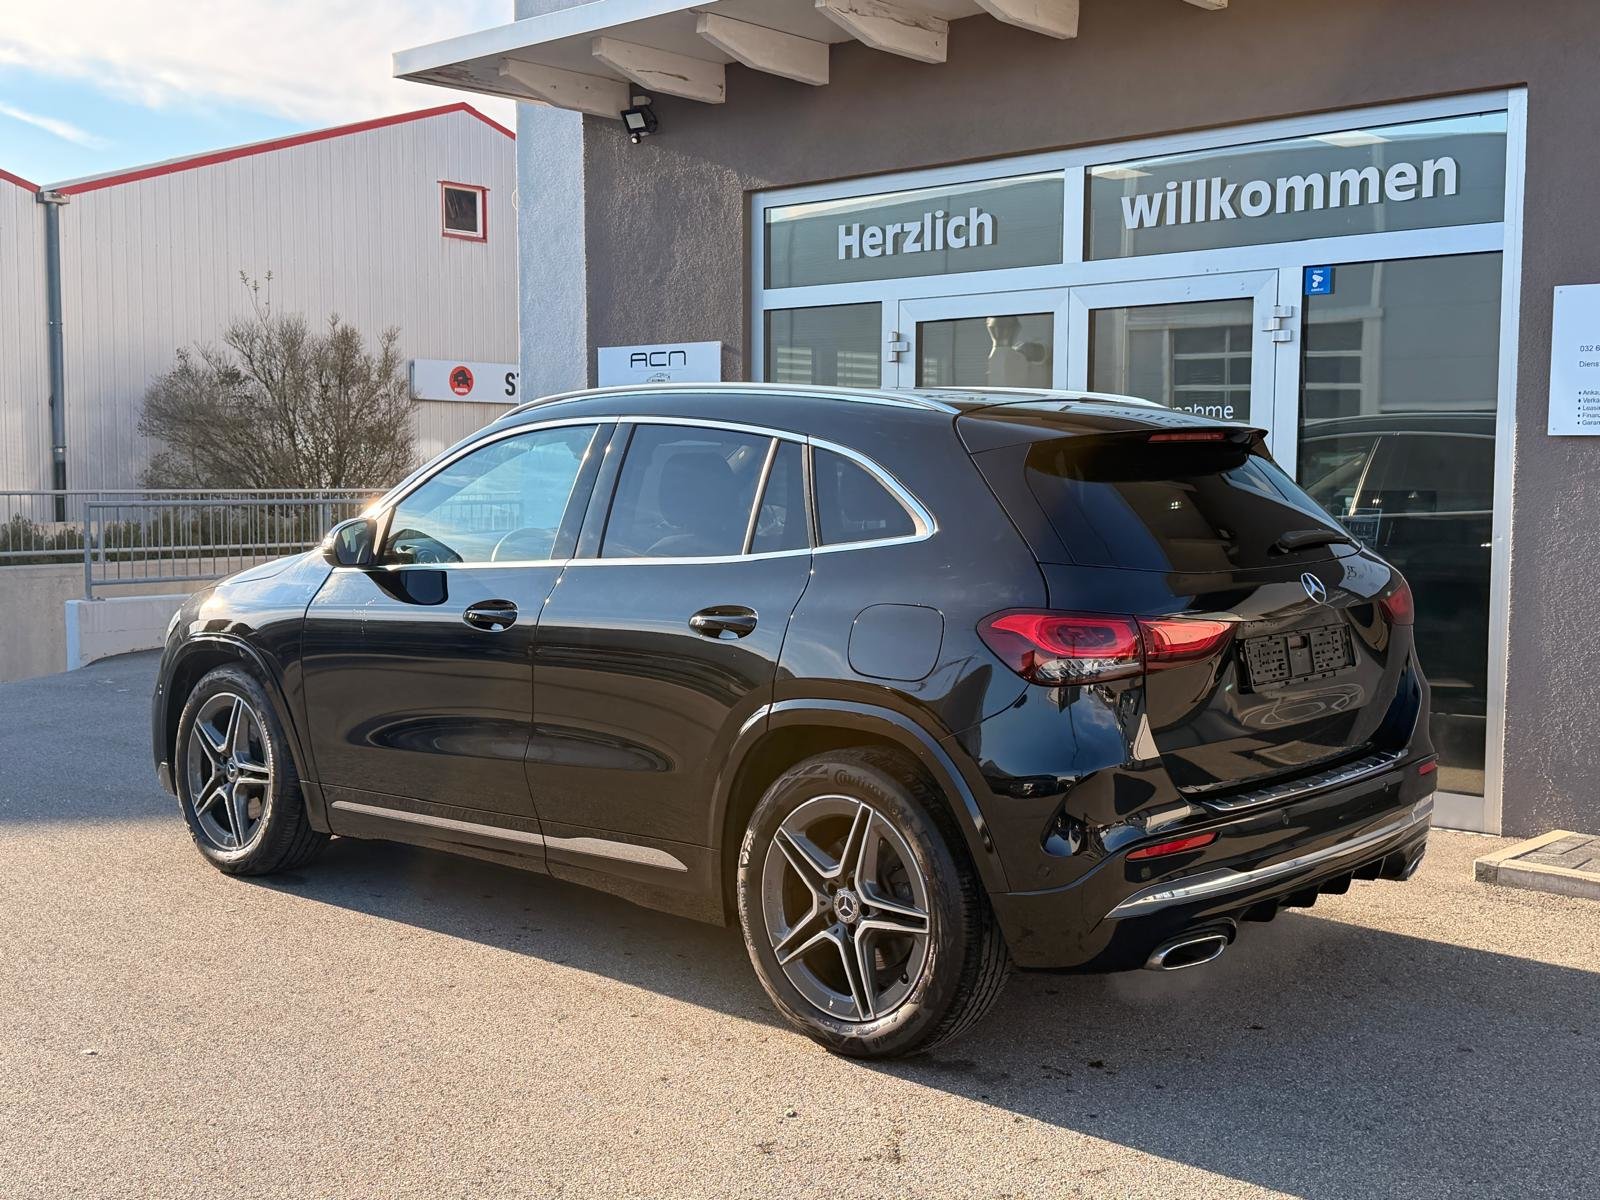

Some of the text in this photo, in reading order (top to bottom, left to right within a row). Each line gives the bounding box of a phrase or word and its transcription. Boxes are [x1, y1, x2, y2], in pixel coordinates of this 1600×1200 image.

[838, 155, 1457, 260] Herzlich willkommen
[630, 350, 687, 369] ACN
[505, 372, 520, 396] S
